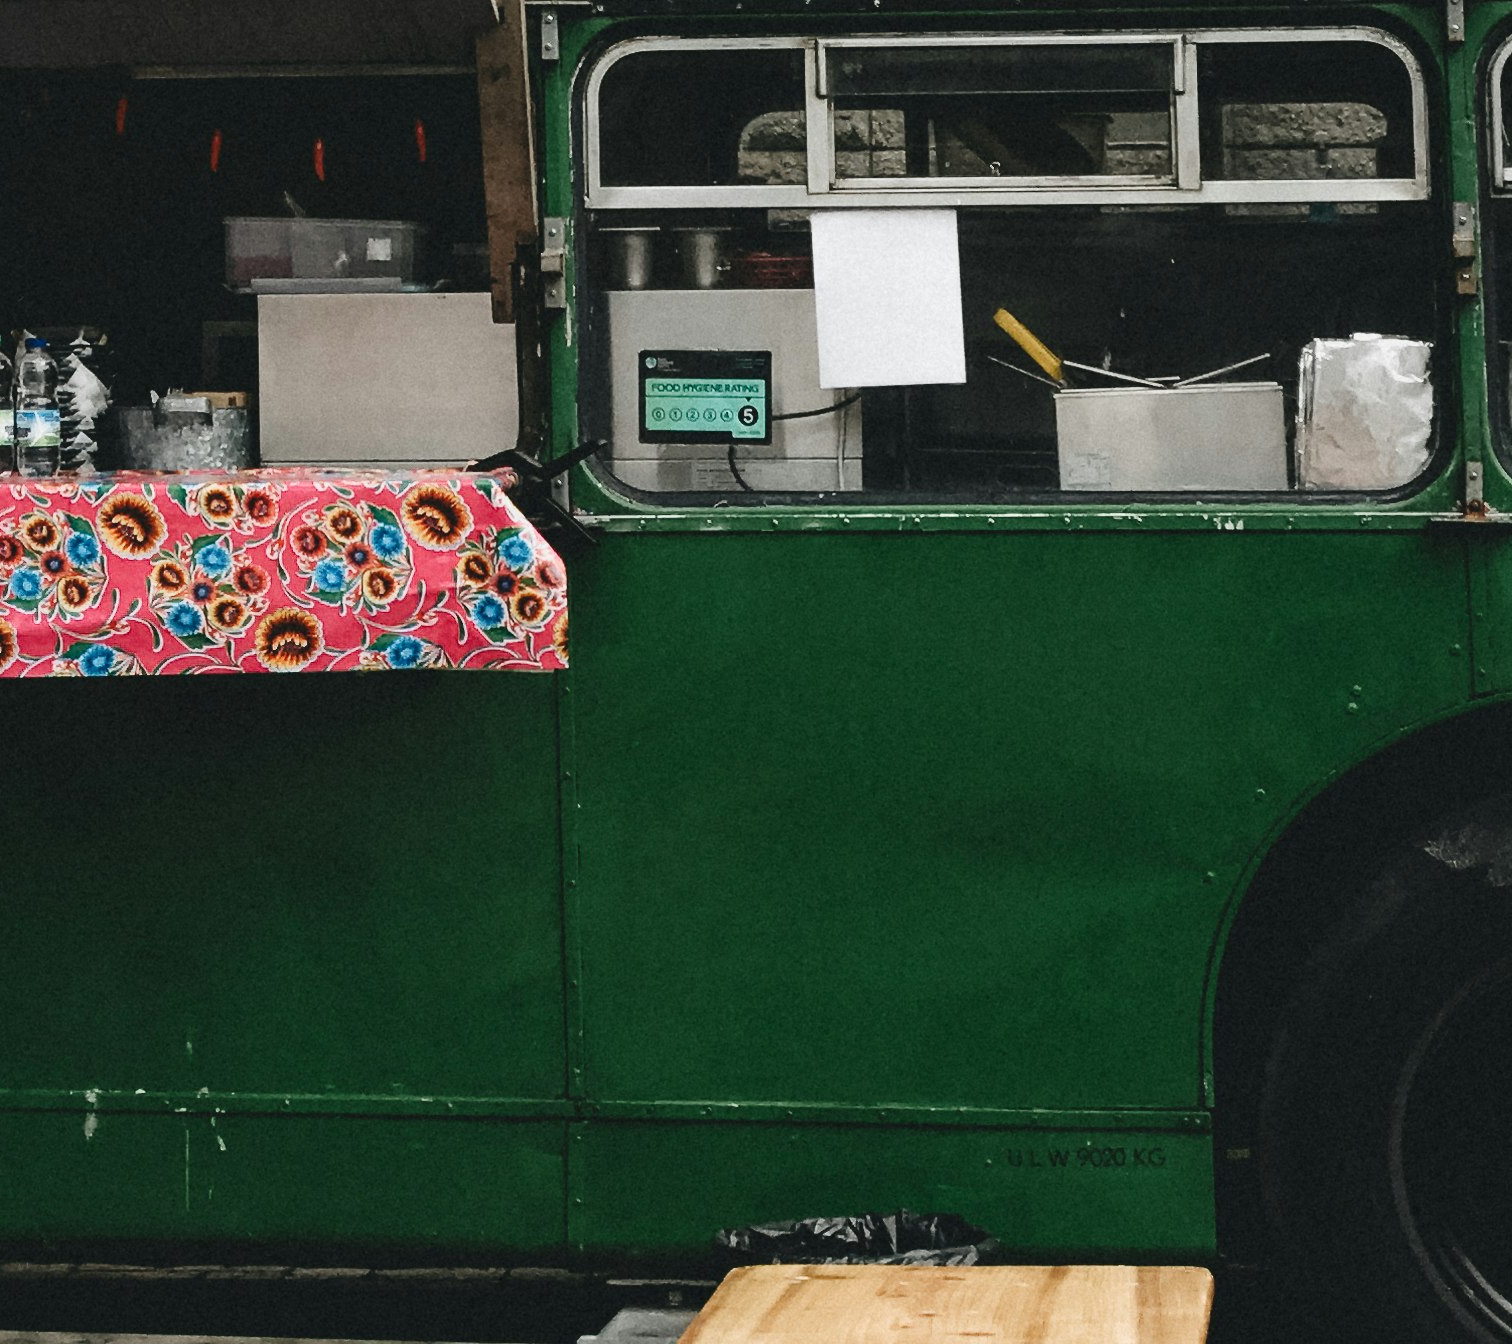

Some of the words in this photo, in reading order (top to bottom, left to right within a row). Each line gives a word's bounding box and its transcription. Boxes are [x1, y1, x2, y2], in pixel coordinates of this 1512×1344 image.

[651, 384, 681, 392] FOOD
[682, 384, 724, 392] HYGIENE
[724, 384, 759, 393] RATING
[743, 408, 754, 424] 5
[1076, 1147, 1127, 1168] 9020
[1133, 1147, 1167, 1167] KG
